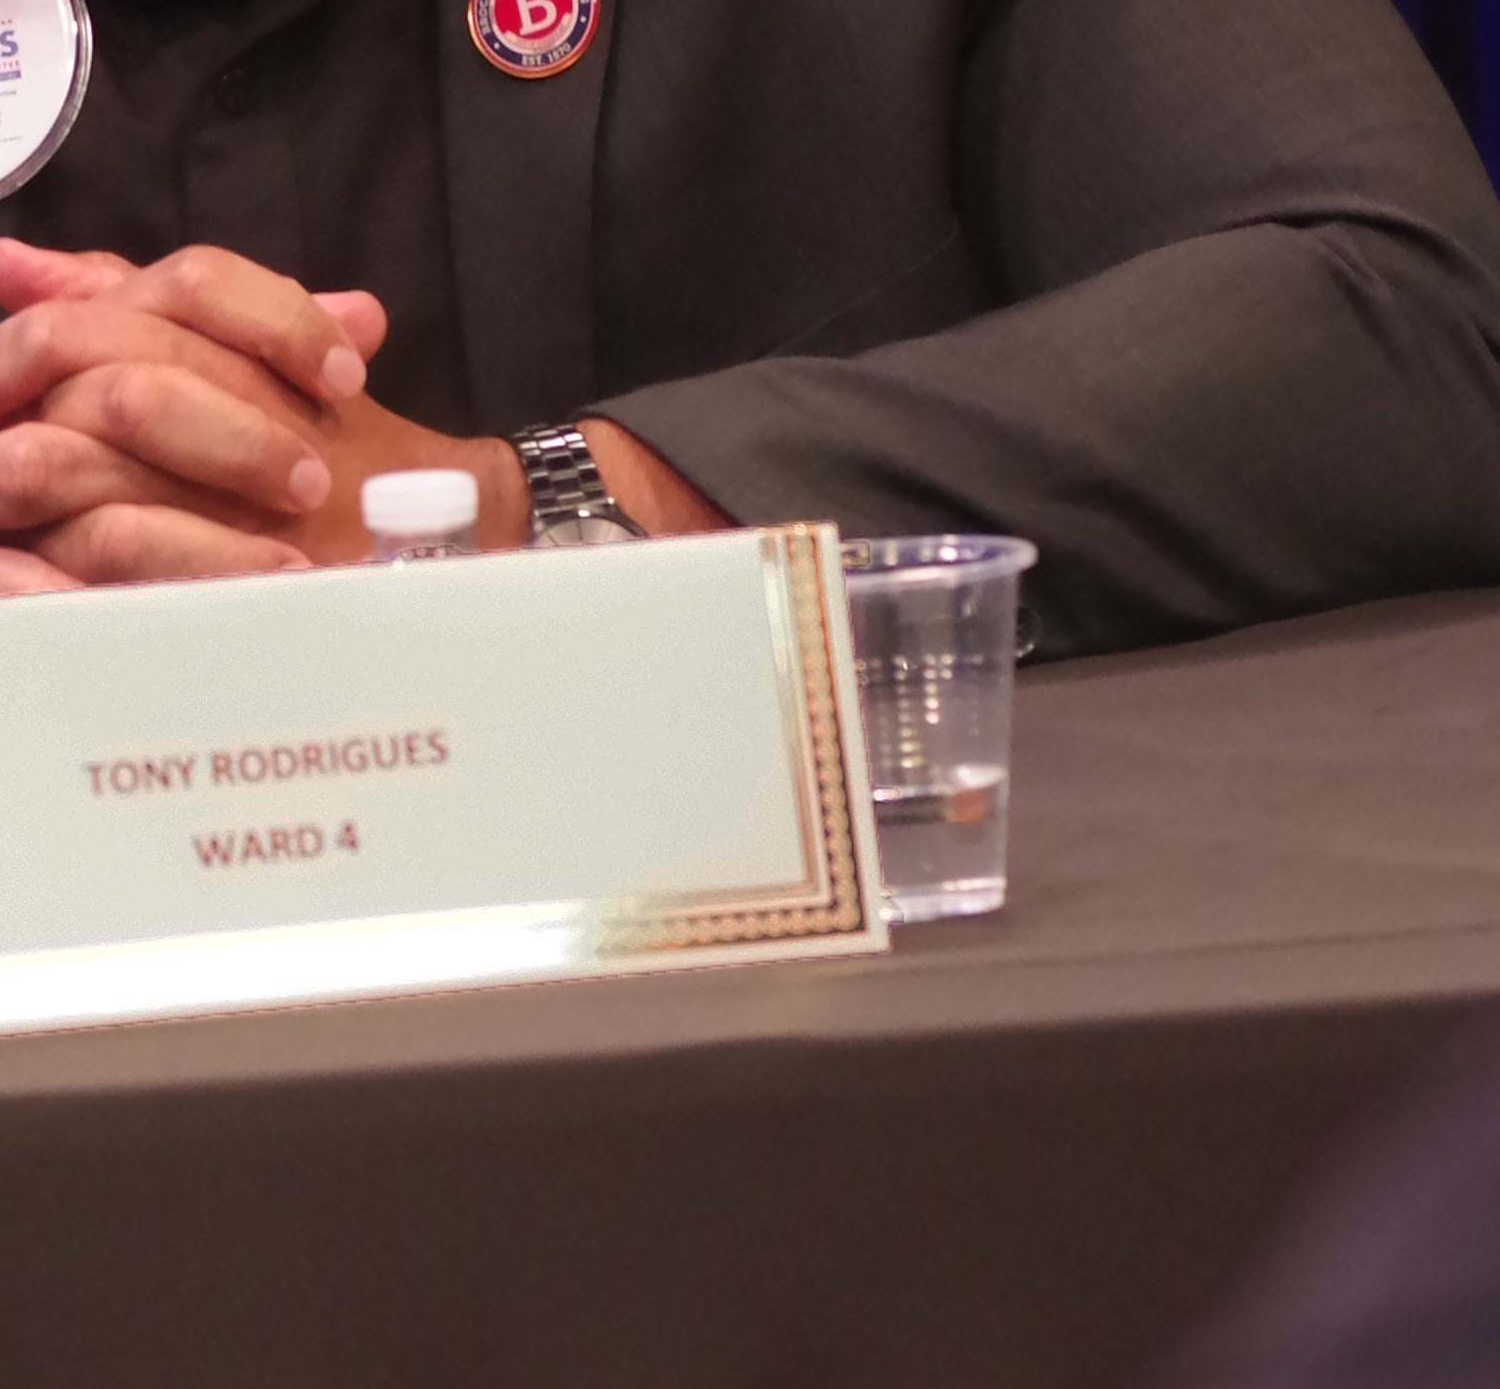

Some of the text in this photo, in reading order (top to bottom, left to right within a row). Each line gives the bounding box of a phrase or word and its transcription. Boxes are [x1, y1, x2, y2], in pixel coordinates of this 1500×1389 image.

[86, 731, 450, 795] TONY RODRIGUES
[194, 819, 359, 867] WARD 4
